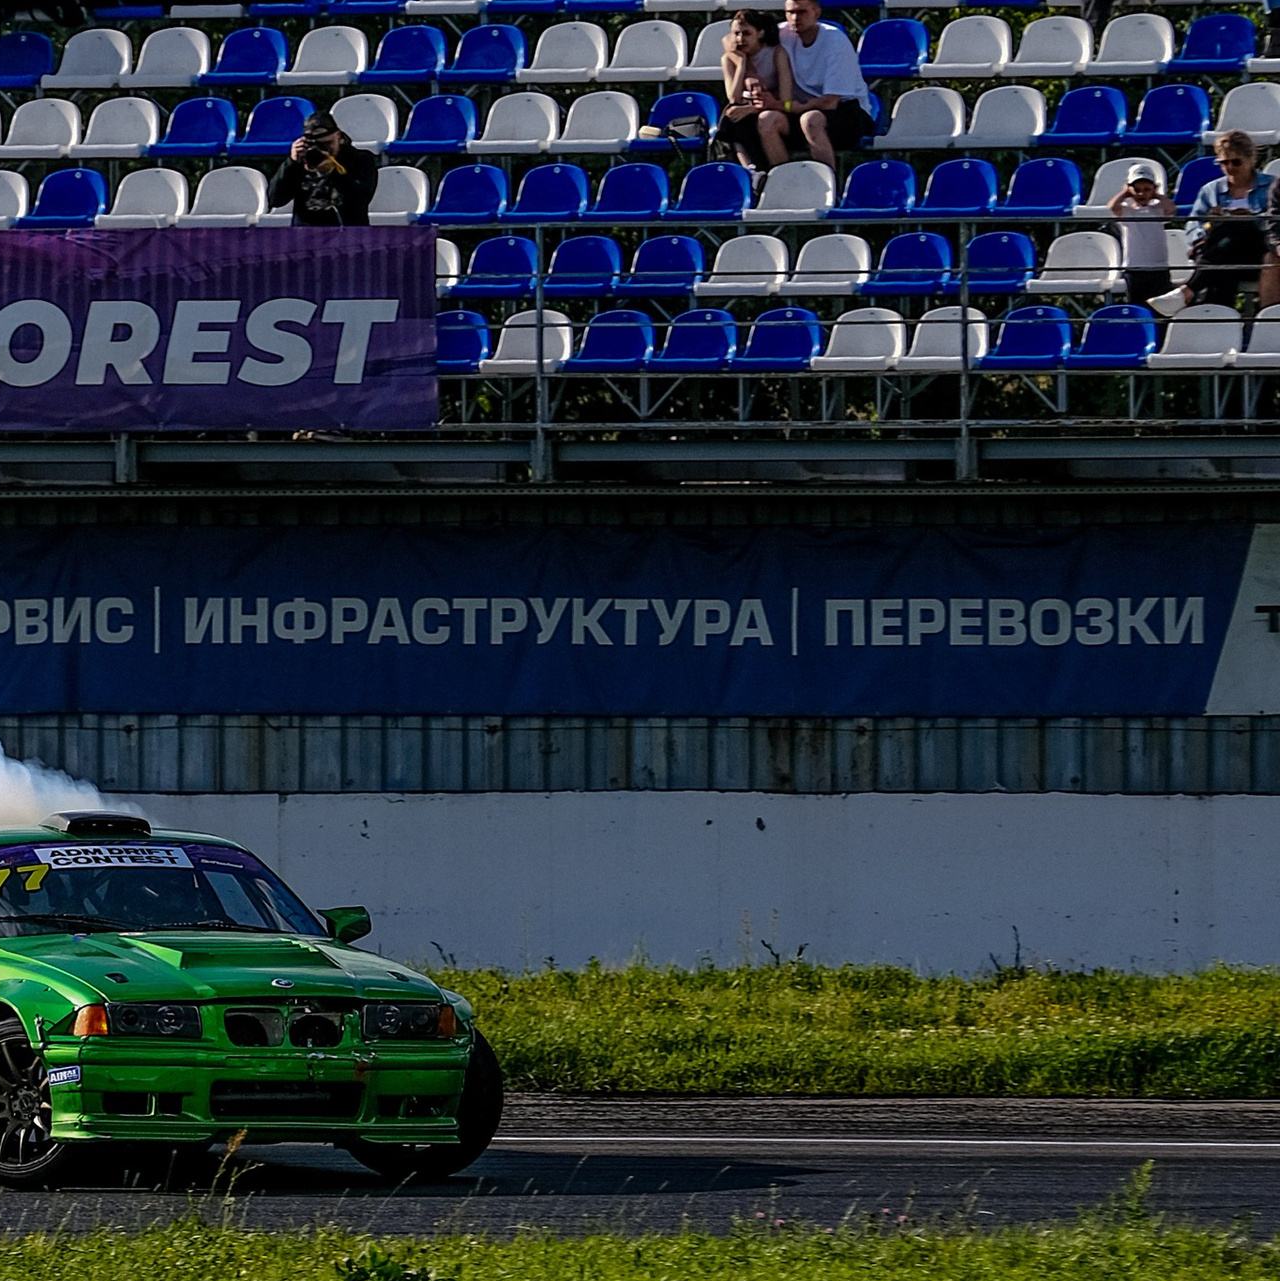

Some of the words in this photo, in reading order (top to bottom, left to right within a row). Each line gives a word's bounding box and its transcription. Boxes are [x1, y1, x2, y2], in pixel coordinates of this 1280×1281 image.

[184, 595, 775, 647] ИНФРАСТРУКТУРА
[824, 595, 1206, 647] ПЕРЕВОЗКИ
[50, 848, 107, 857] ADM
[107, 847, 175, 856] DRIFT
[53, 855, 180, 866] CONTEST
